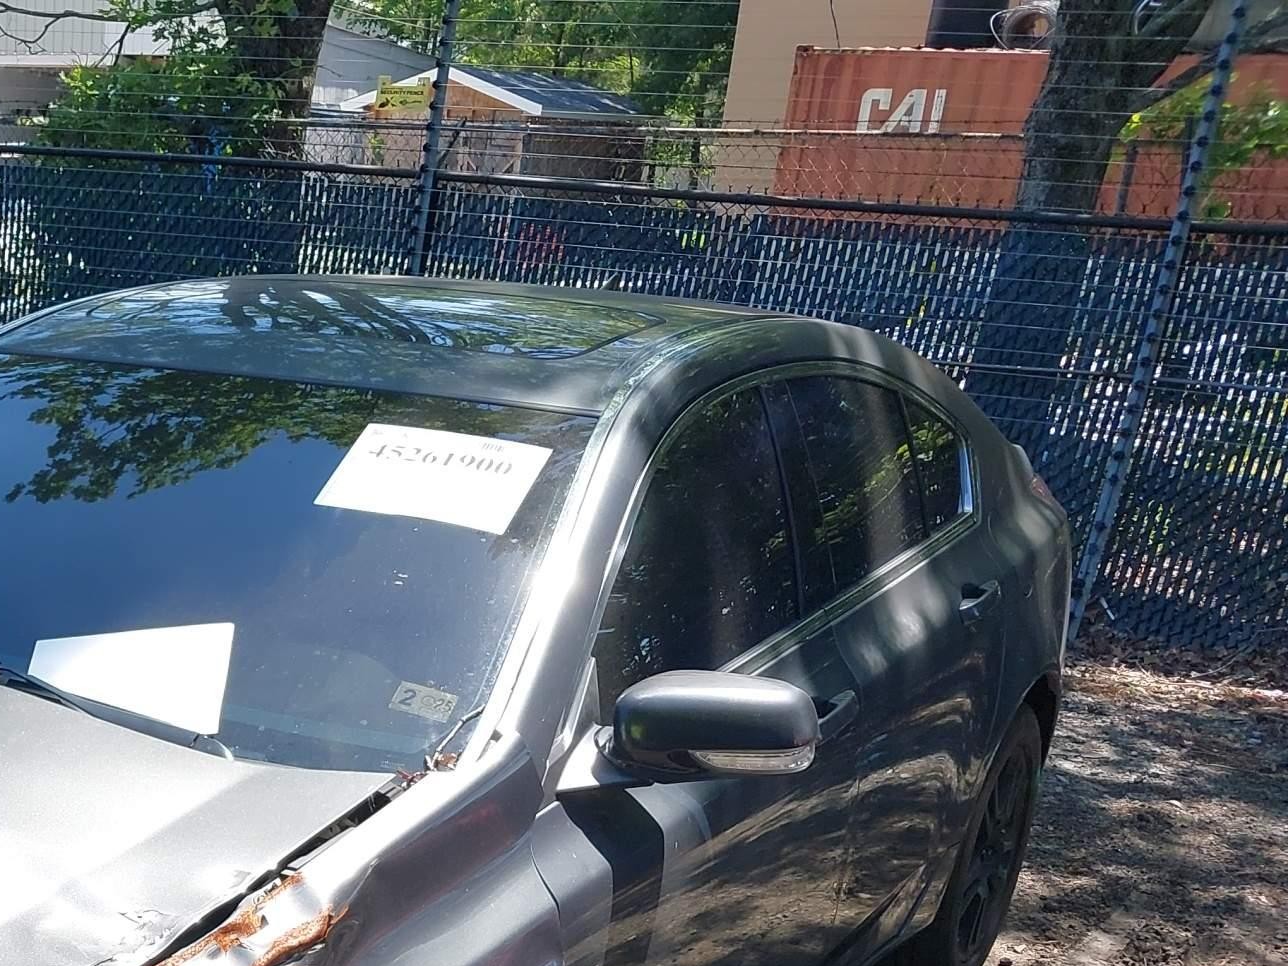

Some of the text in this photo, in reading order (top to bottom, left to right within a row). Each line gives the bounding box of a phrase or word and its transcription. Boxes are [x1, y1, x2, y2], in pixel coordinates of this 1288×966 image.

[856, 88, 947, 133] CAI
[368, 444, 513, 475] 45261900
[398, 688, 417, 707] 2
